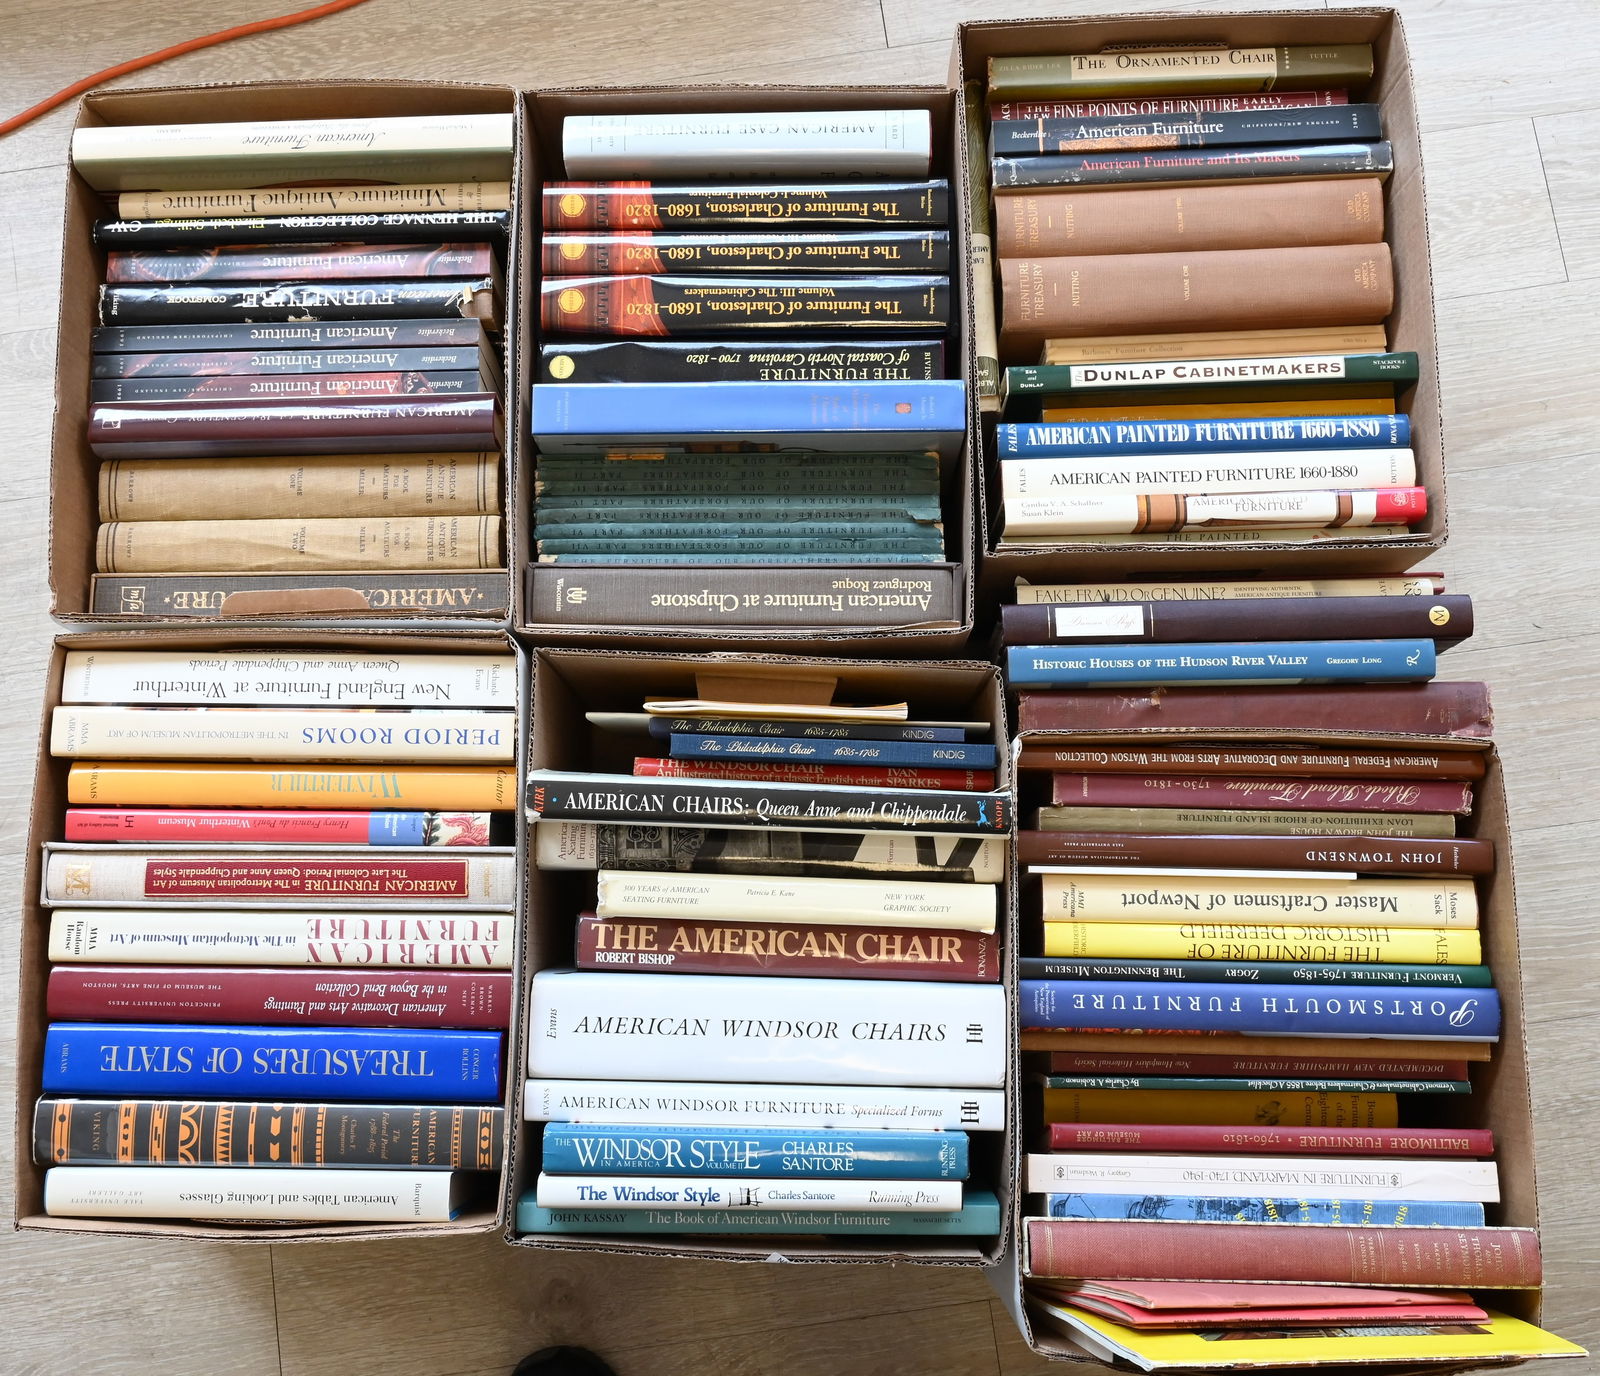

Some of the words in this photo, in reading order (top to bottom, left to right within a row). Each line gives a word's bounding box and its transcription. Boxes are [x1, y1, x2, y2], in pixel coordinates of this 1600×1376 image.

[1228, 50, 1275, 65] CHAIR
[1075, 125, 1148, 140] American
[1151, 122, 1224, 136] Furniture
[241, 136, 310, 151] Furniture
[315, 131, 386, 147] American
[1079, 159, 1141, 171] American
[1144, 156, 1204, 169] Furniture
[1206, 153, 1230, 165] and
[1233, 153, 1251, 165] Its
[163, 193, 257, 213] Furniture
[263, 189, 343, 208] Antique
[348, 188, 446, 206] Miniature
[281, 215, 379, 227] COLLECTION
[382, 213, 459, 225] HENNAGE
[461, 213, 496, 224] THE
[262, 256, 333, 271] Furniture
[337, 254, 409, 269] American
[437, 255, 473, 265] Beckerdite
[167, 295, 227, 303] COMSTOCK
[241, 288, 395, 308] FURNITURE
[706, 300, 784, 315] Charleston,
[788, 301, 803, 315] of
[805, 301, 871, 315] Furniture
[875, 301, 901, 315] The
[748, 353, 806, 366] Carolina
[808, 353, 845, 366] North
[848, 353, 895, 366] Coastal
[896, 349, 910, 366] of
[759, 368, 868, 380] FURNITURE
[871, 367, 910, 379] THE
[1083, 368, 1167, 382] DUNLAP
[1172, 362, 1342, 379] CABINETMAKERS
[1025, 425, 1112, 446] AMERICAN
[1115, 423, 1191, 445] PAINTED
[1194, 421, 1295, 443] FURNITURE
[1300, 418, 1380, 440] 1660-1880
[832, 578, 870, 592] Roque
[873, 578, 932, 592] Rodriguez
[650, 589, 740, 612] Chipstone
[743, 594, 760, 607] at
[763, 594, 844, 612] Furniture
[848, 594, 932, 612] American
[133, 680, 227, 698] Winterthur
[234, 682, 249, 693] at
[256, 681, 330, 699] Furniture
[335, 680, 405, 700] England
[411, 683, 451, 700] New
[301, 728, 393, 745] ROOMS
[403, 728, 500, 746] PERIOD
[699, 741, 723, 752] The
[725, 742, 785, 758] Philadelphia
[788, 743, 815, 756] Chair
[932, 749, 966, 760] KINDIG
[1055, 751, 1109, 765] COLLECTION
[1151, 753, 1168, 763] THE
[1170, 752, 1195, 763] FROM
[1111, 752, 1149, 765] WATSON
[1197, 753, 1221, 766] ARTS
[1280, 754, 1299, 764] AND
[1301, 754, 1350, 768] FURNITURE
[1352, 755, 1391, 769] FEDERAL
[1393, 755, 1440, 769] AMERICAN
[1224, 781, 1304, 801] Furniture
[1302, 782, 1364, 803] Island
[1366, 784, 1421, 806] Rhode
[563, 792, 665, 812] AMERICAN
[672, 795, 751, 816] CHAIRS:
[757, 798, 800, 820] Queen
[803, 799, 842, 818] Anne
[846, 801, 877, 818] and
[879, 801, 967, 826] Chippendale
[1305, 850, 1394, 863] TOWNSEND
[1400, 852, 1442, 863] JOHN
[1121, 889, 1200, 911] Newport
[1206, 894, 1227, 911] of
[1234, 894, 1328, 912] Craftsmen
[1335, 895, 1399, 913] Master
[64, 924, 75, 951] House
[74, 920, 85, 956] Random
[305, 919, 499, 942] FURNITURE
[88, 926, 99, 951] MMA
[591, 924, 659, 951] THE
[668, 926, 848, 959] AMERICAN
[854, 932, 964, 963] CHAIR
[305, 943, 498, 966] AMERICAN
[595, 952, 636, 963] ROBERT
[638, 953, 676, 965] BISHOP
[976, 937, 986, 977] BONANZA
[1292, 968, 1347, 980] 1765-1850
[315, 982, 361, 996] Collection
[363, 983, 388, 996] Bend
[390, 979, 420, 997] Bayou
[421, 984, 435, 997] the
[437, 985, 448, 996] in
[179, 1000, 221, 1008] PRINCETON
[263, 997, 306, 1015] Paintings
[308, 1001, 327, 1014] and
[328, 1002, 350, 1015] Arts
[351, 1003, 399, 1017] Decorative
[402, 1003, 448, 1017] American
[1071, 994, 1243, 1013] FURNITURE
[1260, 997, 1479, 1028] PORTSMOUTH
[572, 1016, 710, 1036] AMERICAN
[721, 1019, 840, 1040] WINDSOR
[851, 1022, 947, 1041] CHAIRS
[99, 1045, 195, 1075] STATE
[202, 1047, 243, 1075] OF
[252, 1048, 434, 1078] TREASURES
[559, 1096, 651, 1110] AMERICAN
[657, 1098, 740, 1112] WINDSOR
[745, 1100, 846, 1115] FURNITURE
[92, 1110, 102, 1151] VIKING
[781, 1142, 854, 1155] CHARLES
[1298, 1135, 1383, 1149] FURNITURE
[1389, 1137, 1470, 1150] BALTIMORE
[571, 1138, 687, 1168] WINDSOR
[689, 1140, 762, 1169] STYLE
[781, 1157, 855, 1171] SANTORE
[178, 1193, 224, 1204] Glasses
[226, 1191, 276, 1205] Looking
[278, 1194, 299, 1206] and
[302, 1194, 341, 1206] Tables
[343, 1195, 399, 1206] American
[576, 1185, 608, 1201] The
[612, 1186, 680, 1202] Windsor
[683, 1187, 721, 1207] Style
[645, 1211, 672, 1224] The
[674, 1211, 706, 1224] Book
[707, 1211, 721, 1224] of
[721, 1212, 780, 1225] American
[780, 1212, 831, 1226] Windsor
[833, 1212, 891, 1226] Furniture
